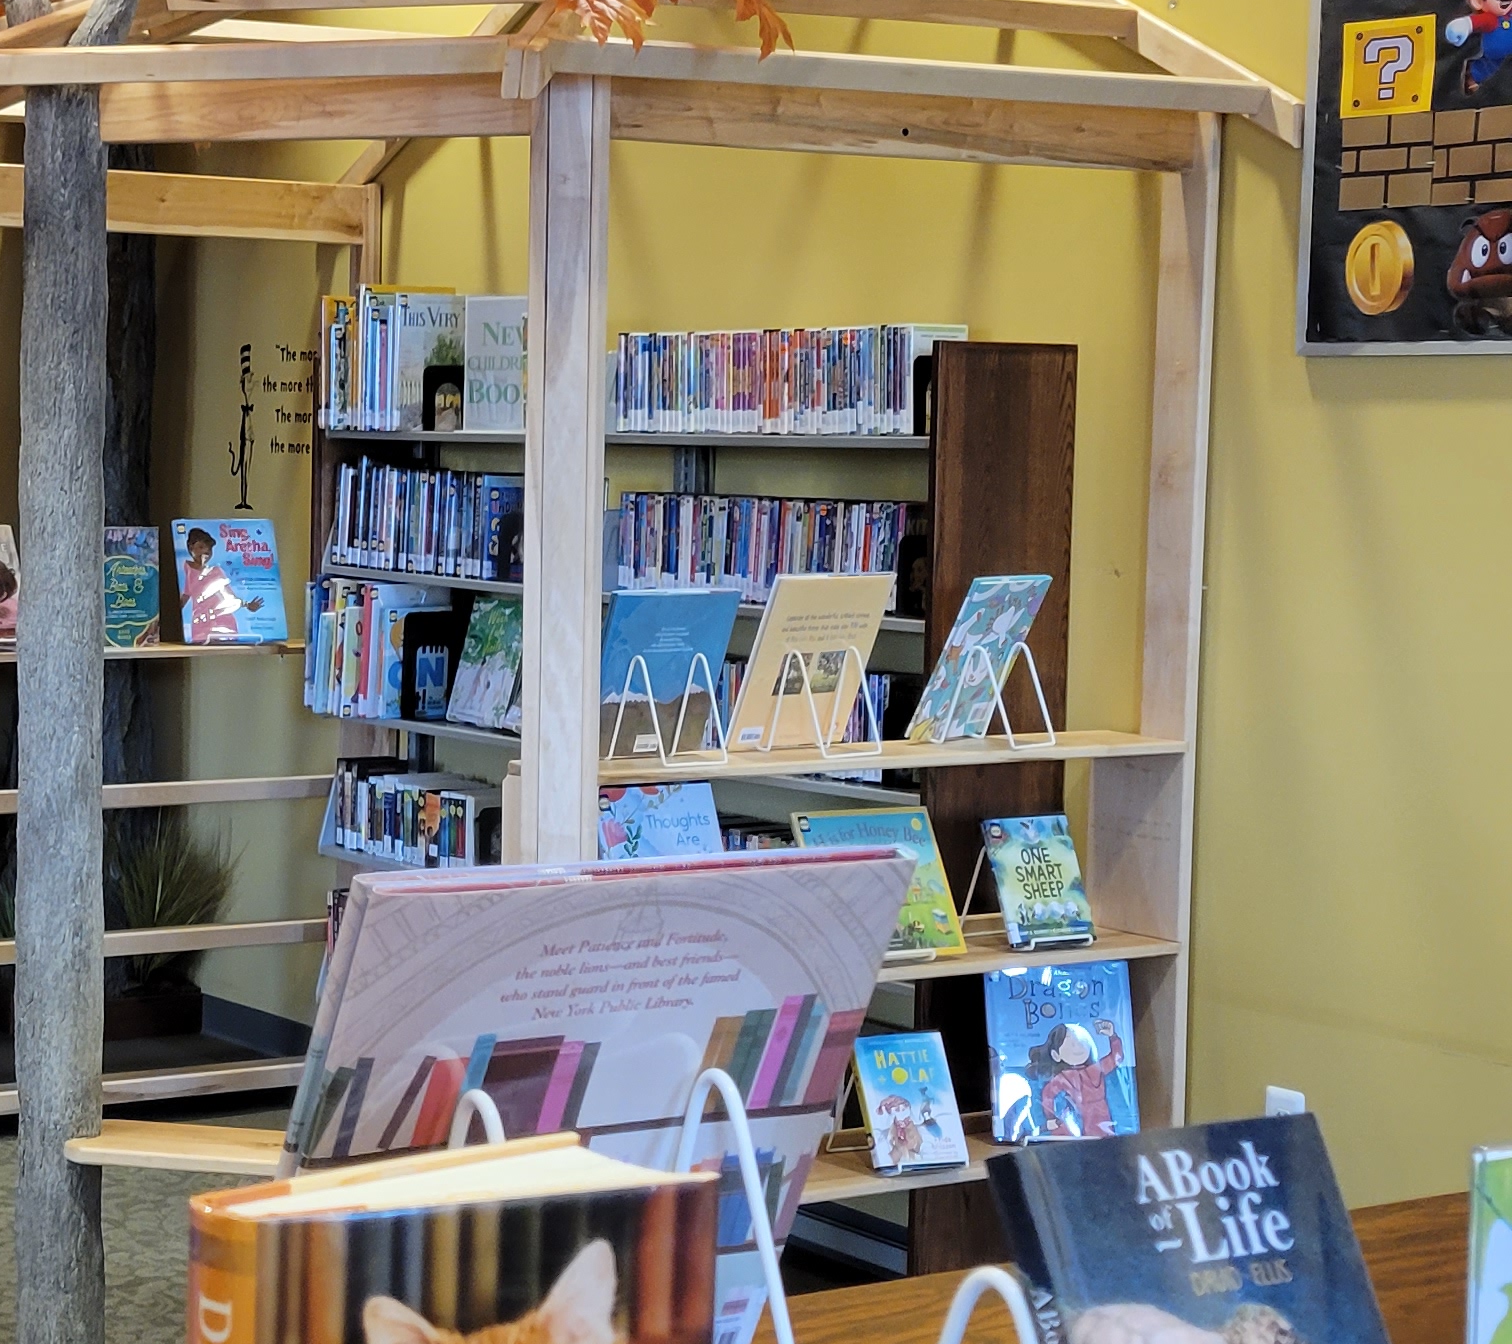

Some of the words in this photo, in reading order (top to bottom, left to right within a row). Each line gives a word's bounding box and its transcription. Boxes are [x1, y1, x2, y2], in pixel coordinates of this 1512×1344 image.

[299, 350, 317, 362] mor
[467, 378, 521, 405] BOO
[294, 411, 312, 423] mor
[646, 811, 711, 832] Thoughts
[676, 832, 700, 847] Are
[1020, 847, 1052, 865] ONE
[1015, 862, 1064, 883] SMART
[1022, 880, 1065, 901] SHEEP
[540, 942, 575, 957] Meet
[515, 967, 537, 981] the
[541, 964, 573, 978] noble
[652, 954, 677, 967] best
[500, 988, 528, 1004] who
[531, 984, 567, 1000] stand
[570, 980, 609, 998] guard
[612, 980, 625, 992] in
[628, 977, 659, 994] front
[663, 975, 676, 991] of
[678, 973, 698, 987] the
[699, 969, 741, 987] famed
[531, 1005, 563, 1021] New
[566, 1003, 594, 1018] York
[600, 999, 639, 1015] Public
[1136, 1153, 1174, 1204] A
[1159, 1140, 1281, 1199] Book
[1174, 1191, 1295, 1264] Life
